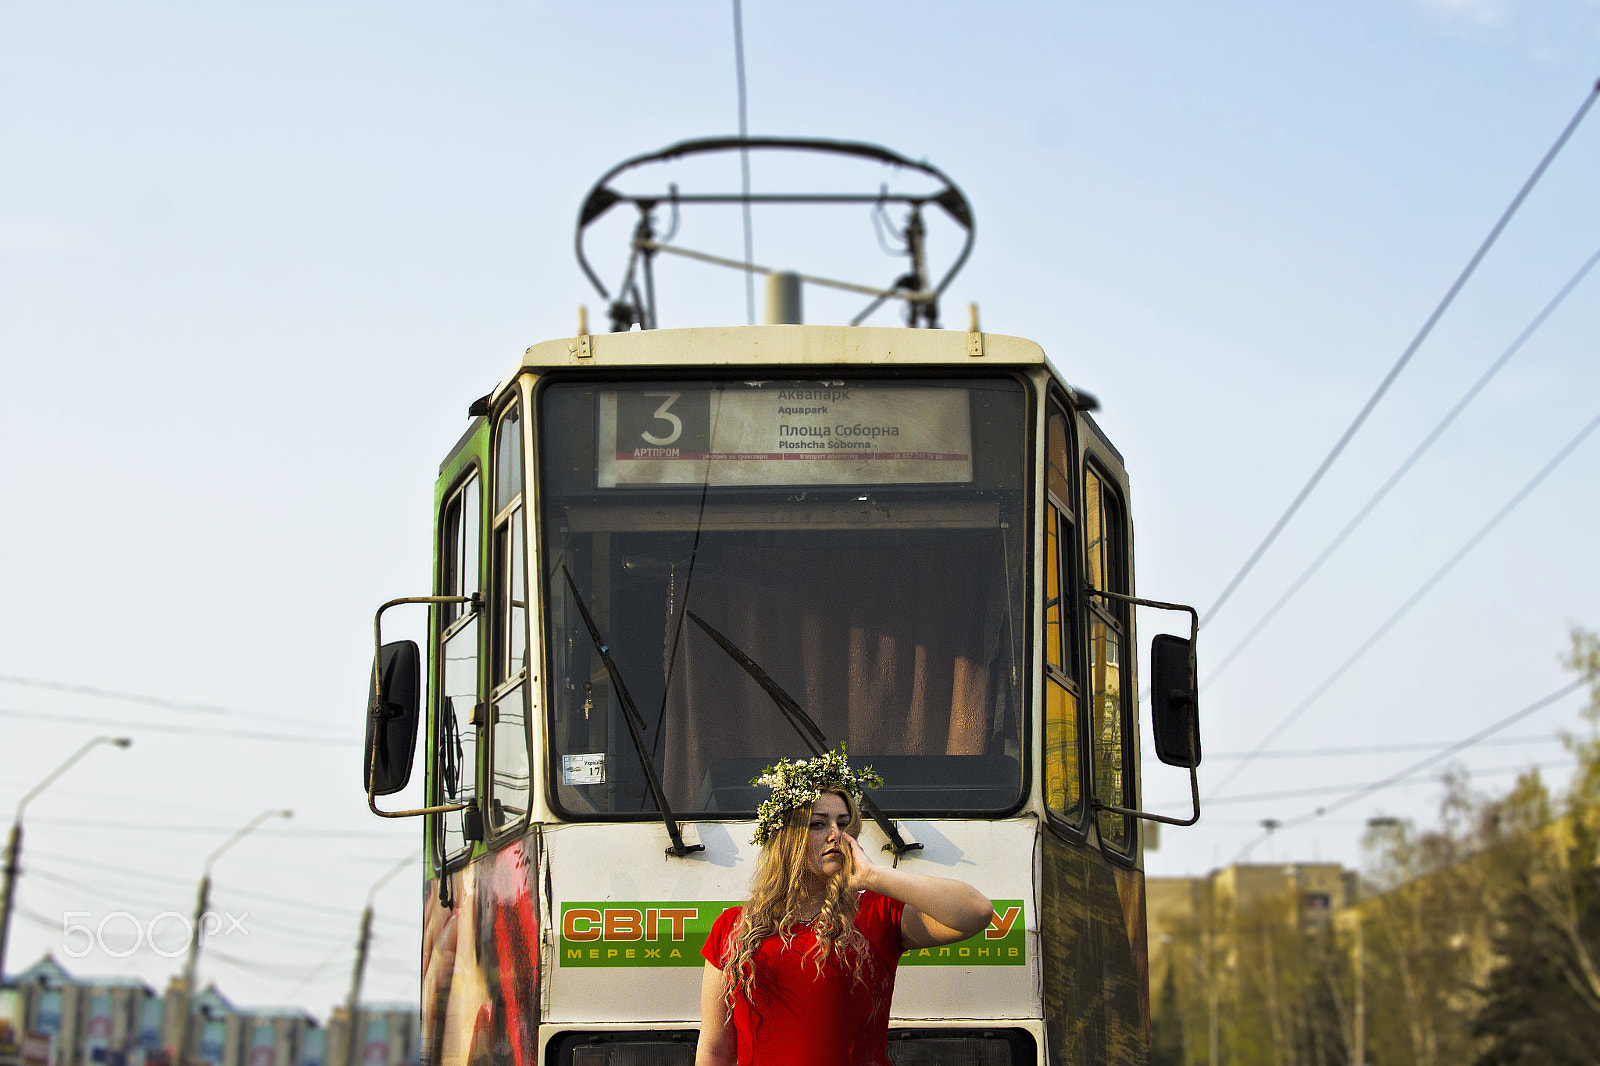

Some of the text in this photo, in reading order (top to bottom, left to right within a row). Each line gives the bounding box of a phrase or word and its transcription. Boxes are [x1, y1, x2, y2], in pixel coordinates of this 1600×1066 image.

[778, 390, 850, 403] Аквапарк
[778, 406, 828, 416] Aquapark
[641, 391, 683, 446] 3
[779, 424, 899, 439] Площа Соборна
[779, 440, 871, 449] Ploshcha Soborna
[634, 448, 680, 458] АРТПРОМ
[590, 767, 600, 776] 17
[563, 908, 699, 942] СВІТ
[567, 949, 682, 959] МЕРЕЖА
